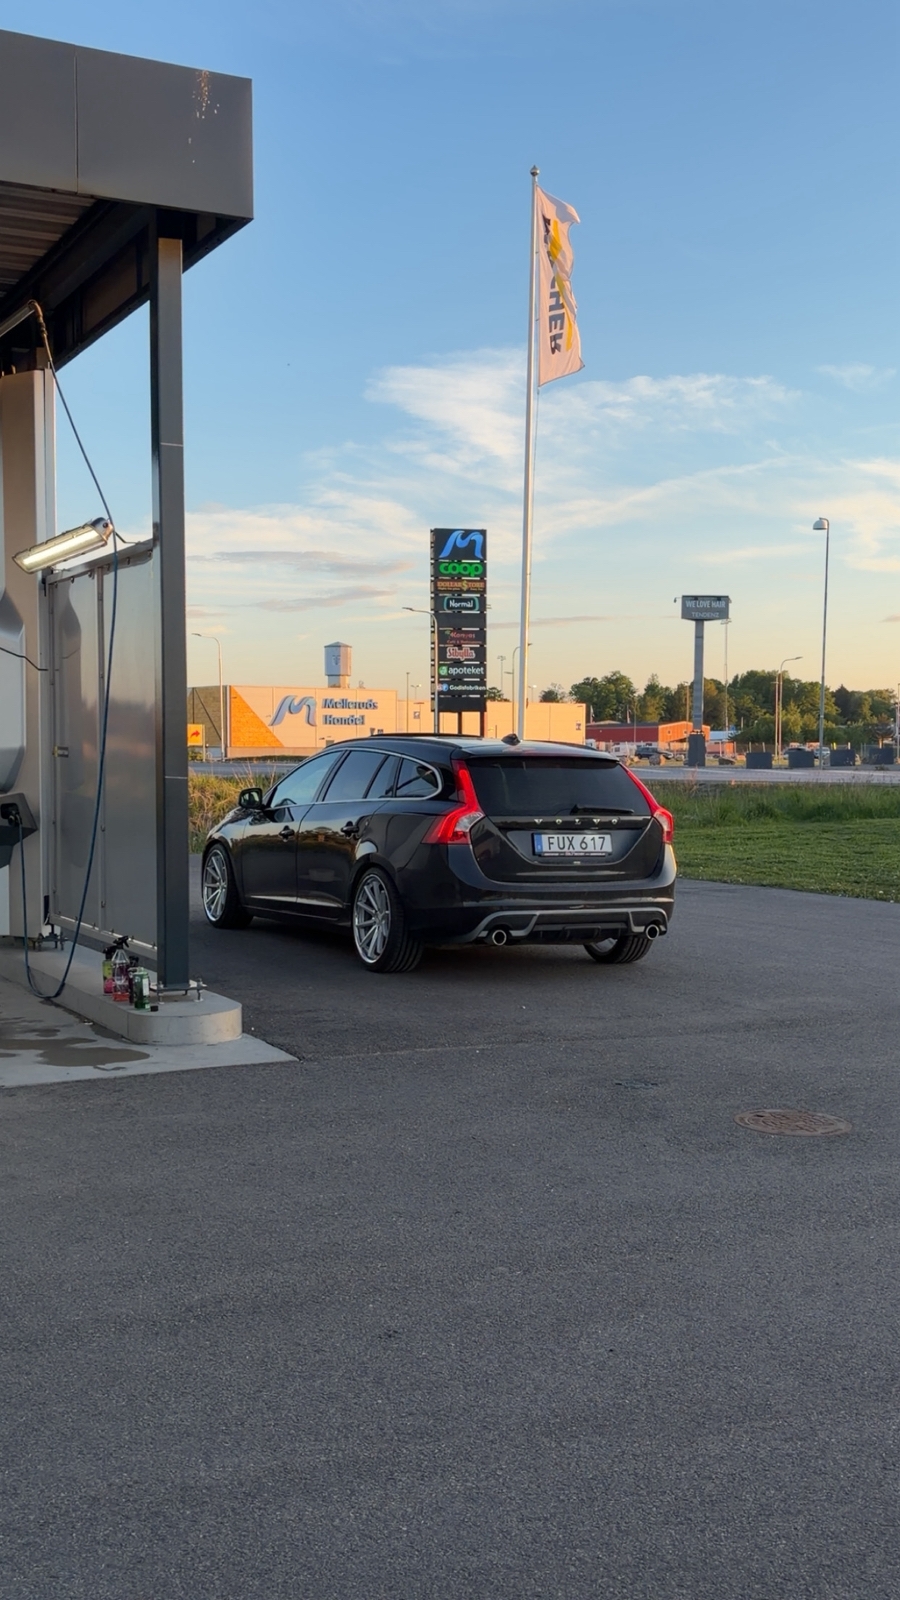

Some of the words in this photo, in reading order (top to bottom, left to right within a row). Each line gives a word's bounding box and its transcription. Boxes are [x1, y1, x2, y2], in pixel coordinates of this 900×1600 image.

[439, 563, 483, 577] coop
[449, 599, 474, 608] Normal
[685, 600, 696, 608] WE
[696, 600, 711, 608] LOVE
[711, 600, 726, 608] HAIR
[446, 646, 476, 661] Sibylla
[448, 666, 485, 676] apoteket
[322, 698, 378, 710] Melleruds
[322, 714, 366, 726] Handel
[547, 836, 576, 851] FUX
[579, 836, 606, 851] 617
